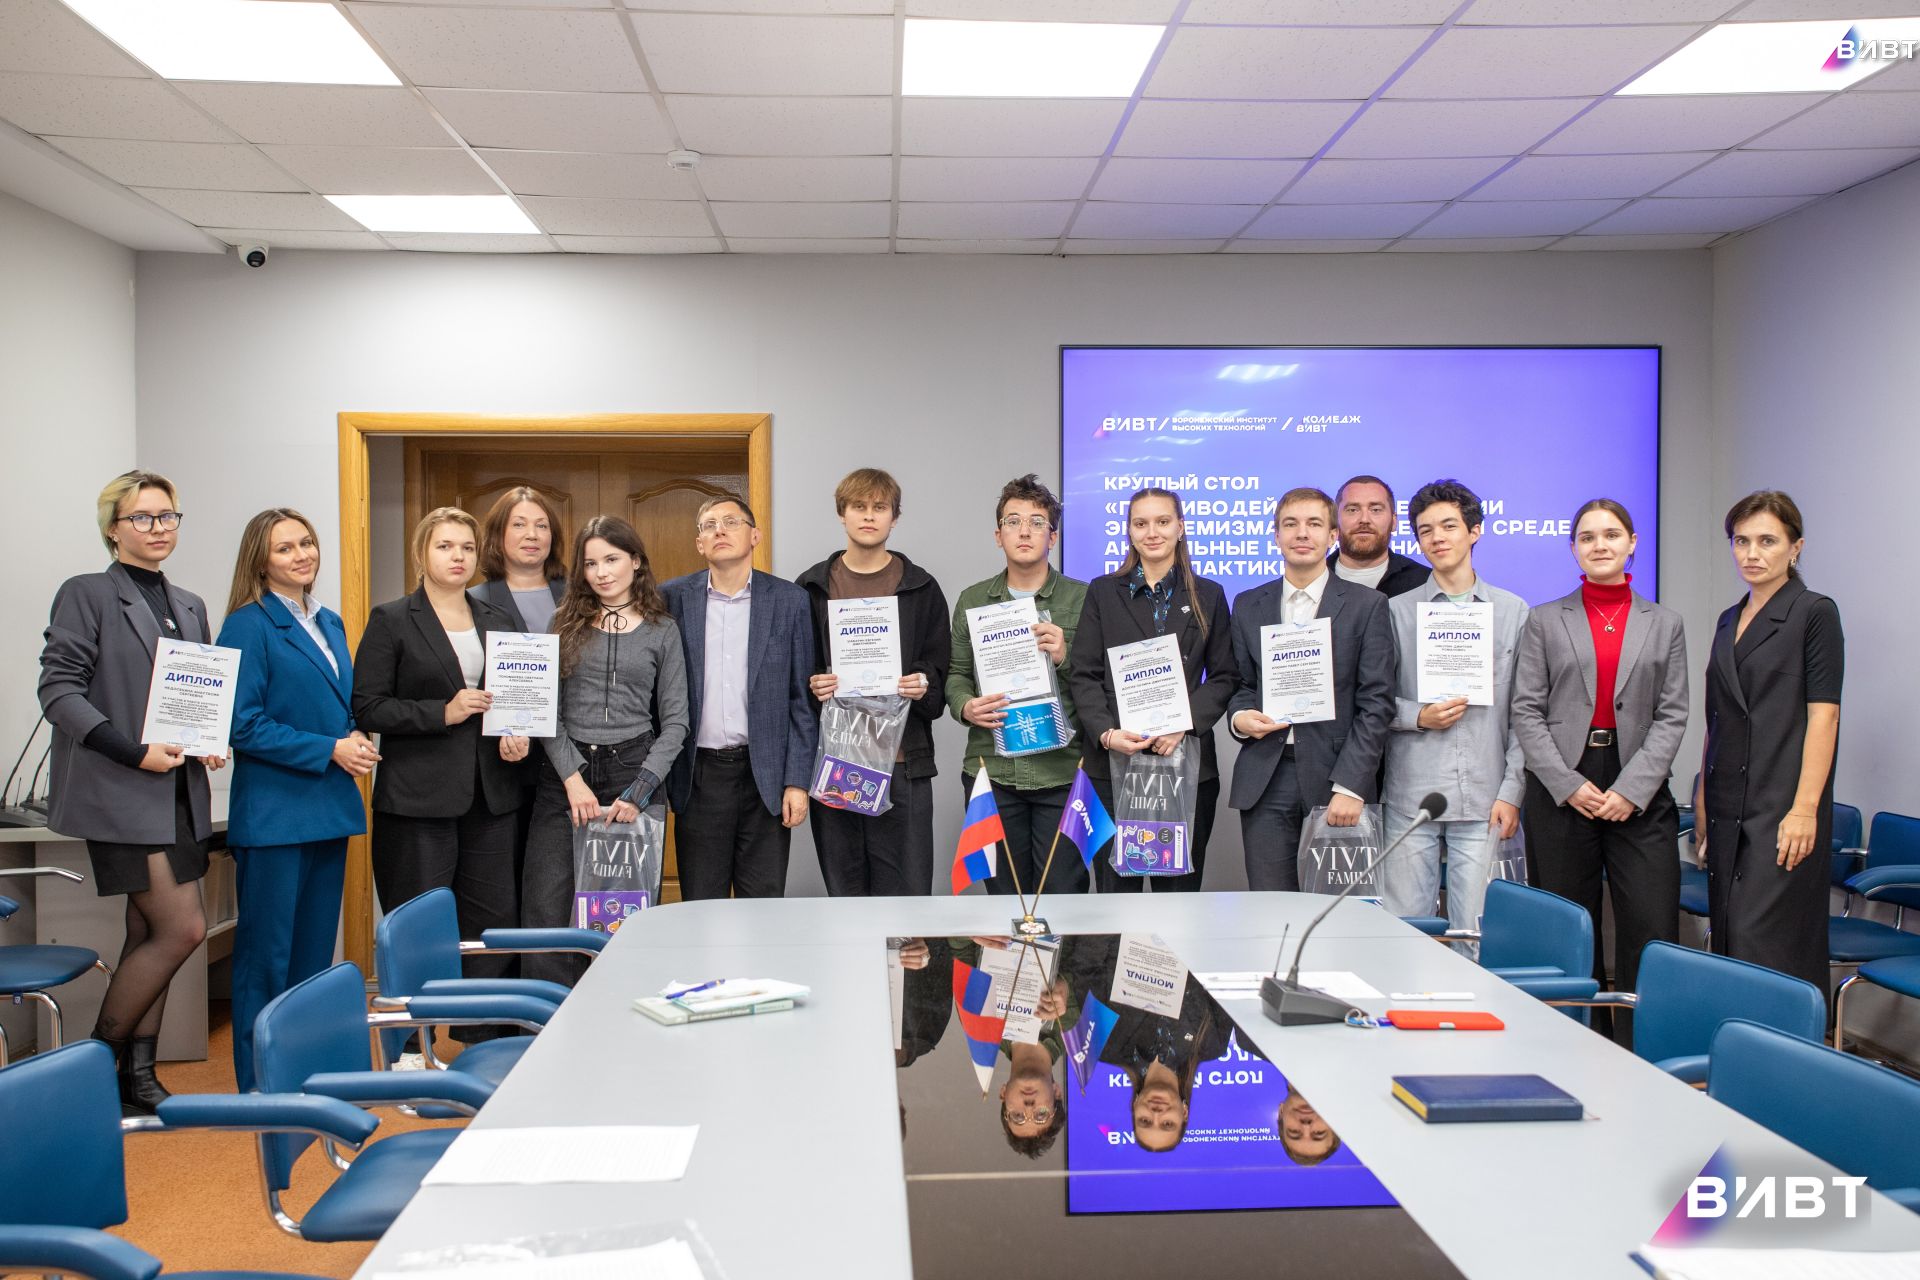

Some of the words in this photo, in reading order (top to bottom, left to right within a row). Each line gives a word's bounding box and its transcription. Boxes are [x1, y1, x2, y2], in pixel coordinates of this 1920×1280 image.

[1102, 417, 1158, 431] ВИВТ
[1236, 416, 1278, 424] ИНСТИТУТ
[1302, 415, 1362, 424] КОЛЛЕДЖ
[1296, 424, 1328, 433] ВИВТ
[1104, 473, 1199, 490] КРУГЛЫЙ
[1204, 476, 1259, 490] СТОЛ
[840, 625, 888, 636] ДИПЛОМ
[982, 627, 1030, 643] ДИПЛОМ
[1428, 631, 1481, 640] ДИПЛОМ
[1272, 648, 1321, 662] ДИПЛОМ
[497, 661, 547, 672] ДИПЛОМ
[1124, 664, 1172, 682] ДИПЛОМ
[165, 672, 223, 688] ДИПЛОМ
[1310, 846, 1378, 871] VIVT
[1327, 871, 1375, 885] FAMILY
